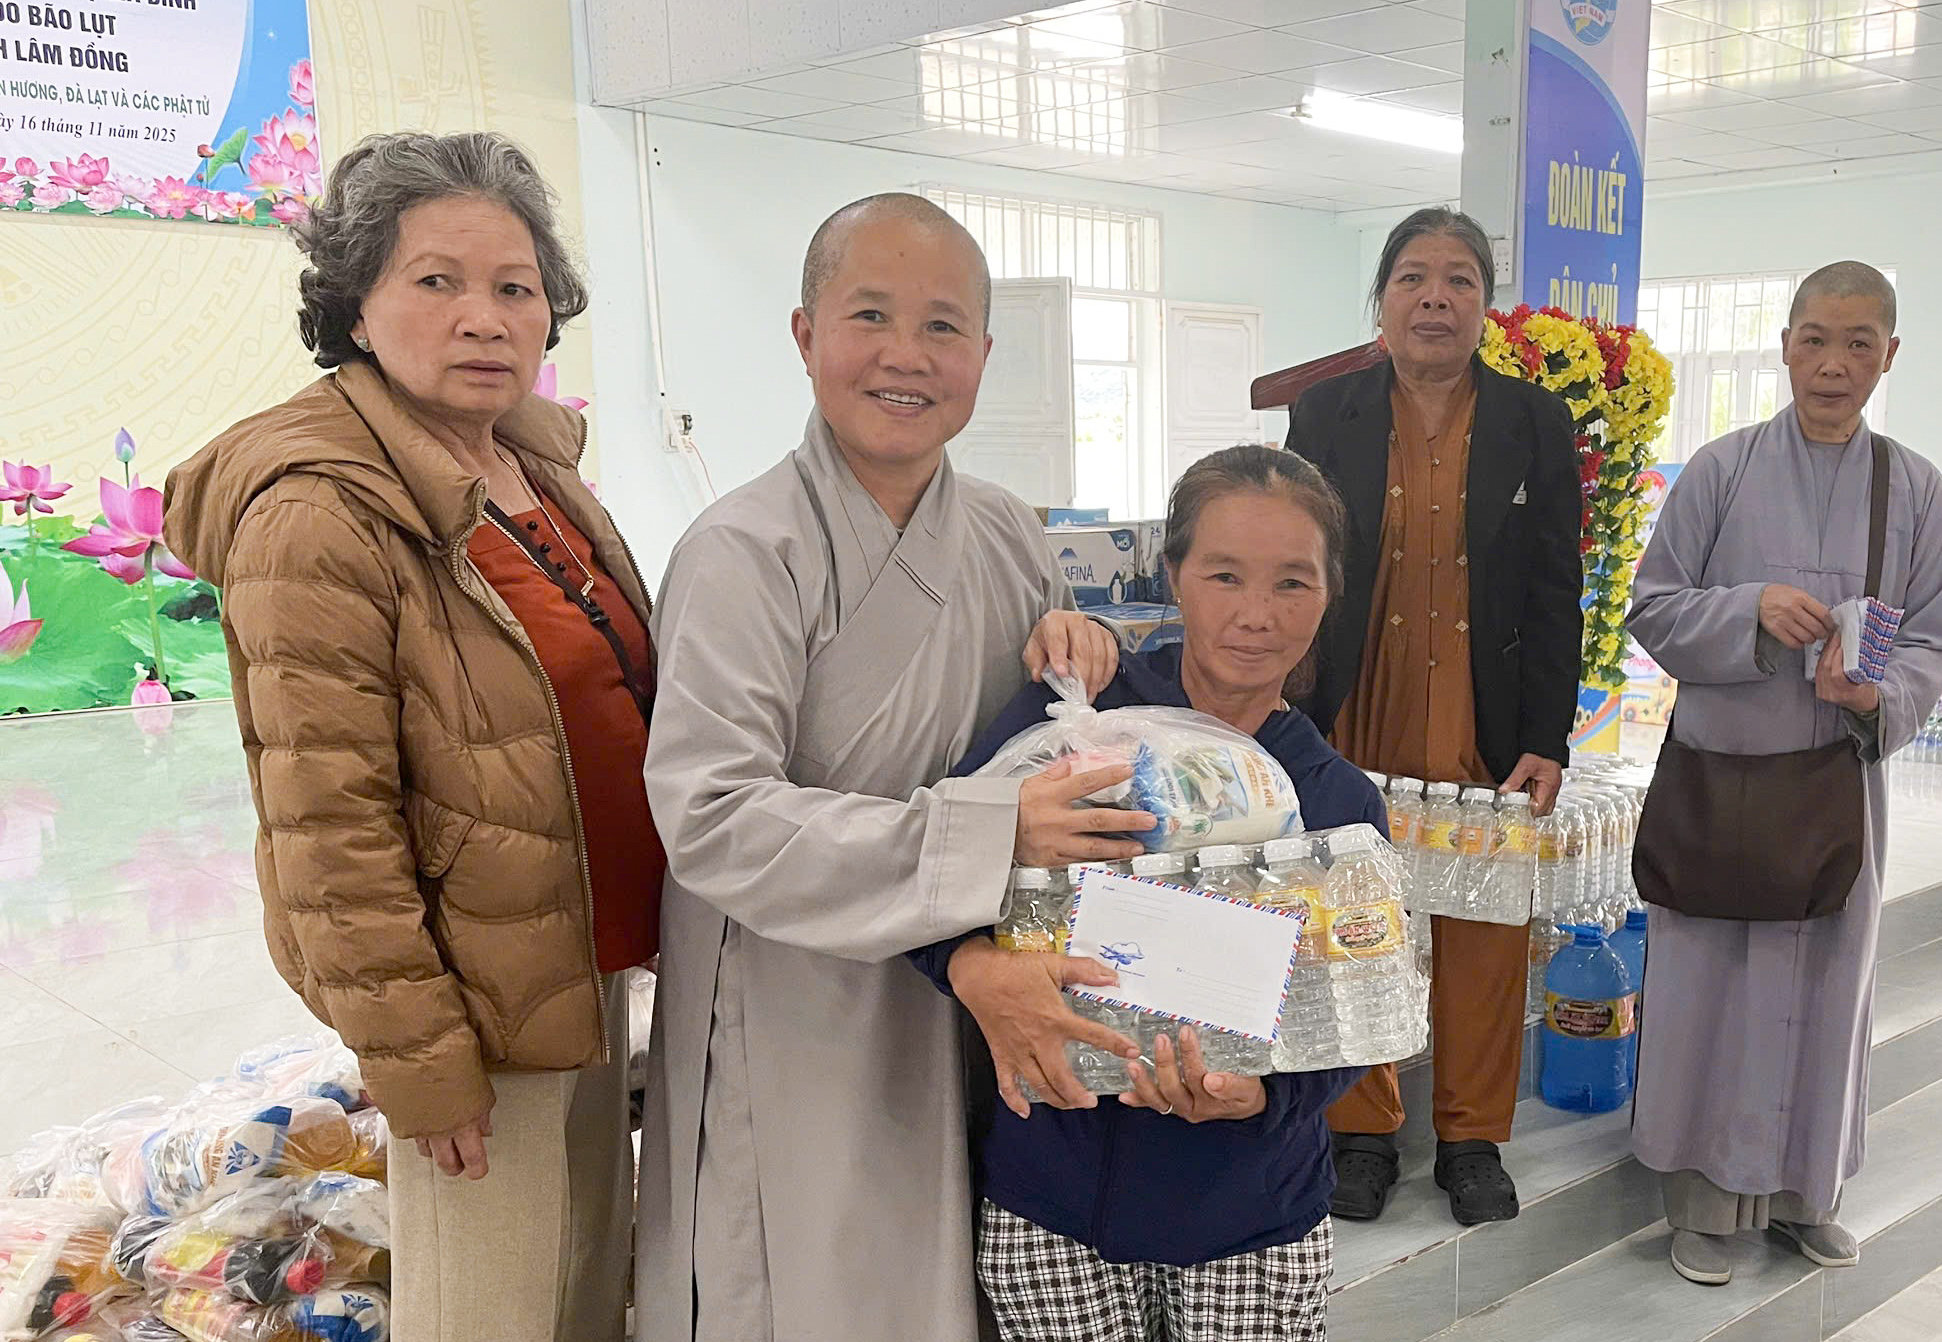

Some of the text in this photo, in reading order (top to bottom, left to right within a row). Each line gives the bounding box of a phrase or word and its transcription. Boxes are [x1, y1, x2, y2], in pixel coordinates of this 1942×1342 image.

[28, 3, 72, 30] BÃO
[79, 11, 116, 38] LỤT
[15, 37, 63, 65] LÂM
[69, 42, 129, 73] ĐỒNG
[66, 82, 84, 104] ĐÀ
[87, 88, 108, 110] LẠT
[111, 87, 129, 108] VÀ
[133, 90, 160, 111] CÁC
[164, 93, 193, 118] PHẬT
[196, 94, 210, 116] TỬ
[20, 115, 37, 130] 16
[41, 117, 83, 138] tháng
[89, 121, 102, 136] 11
[109, 124, 138, 139] năm
[144, 126, 177, 143] 2025
[1548, 150, 1626, 236] ĐOÀN KẾT
[1062, 563, 1094, 582] AFINA
